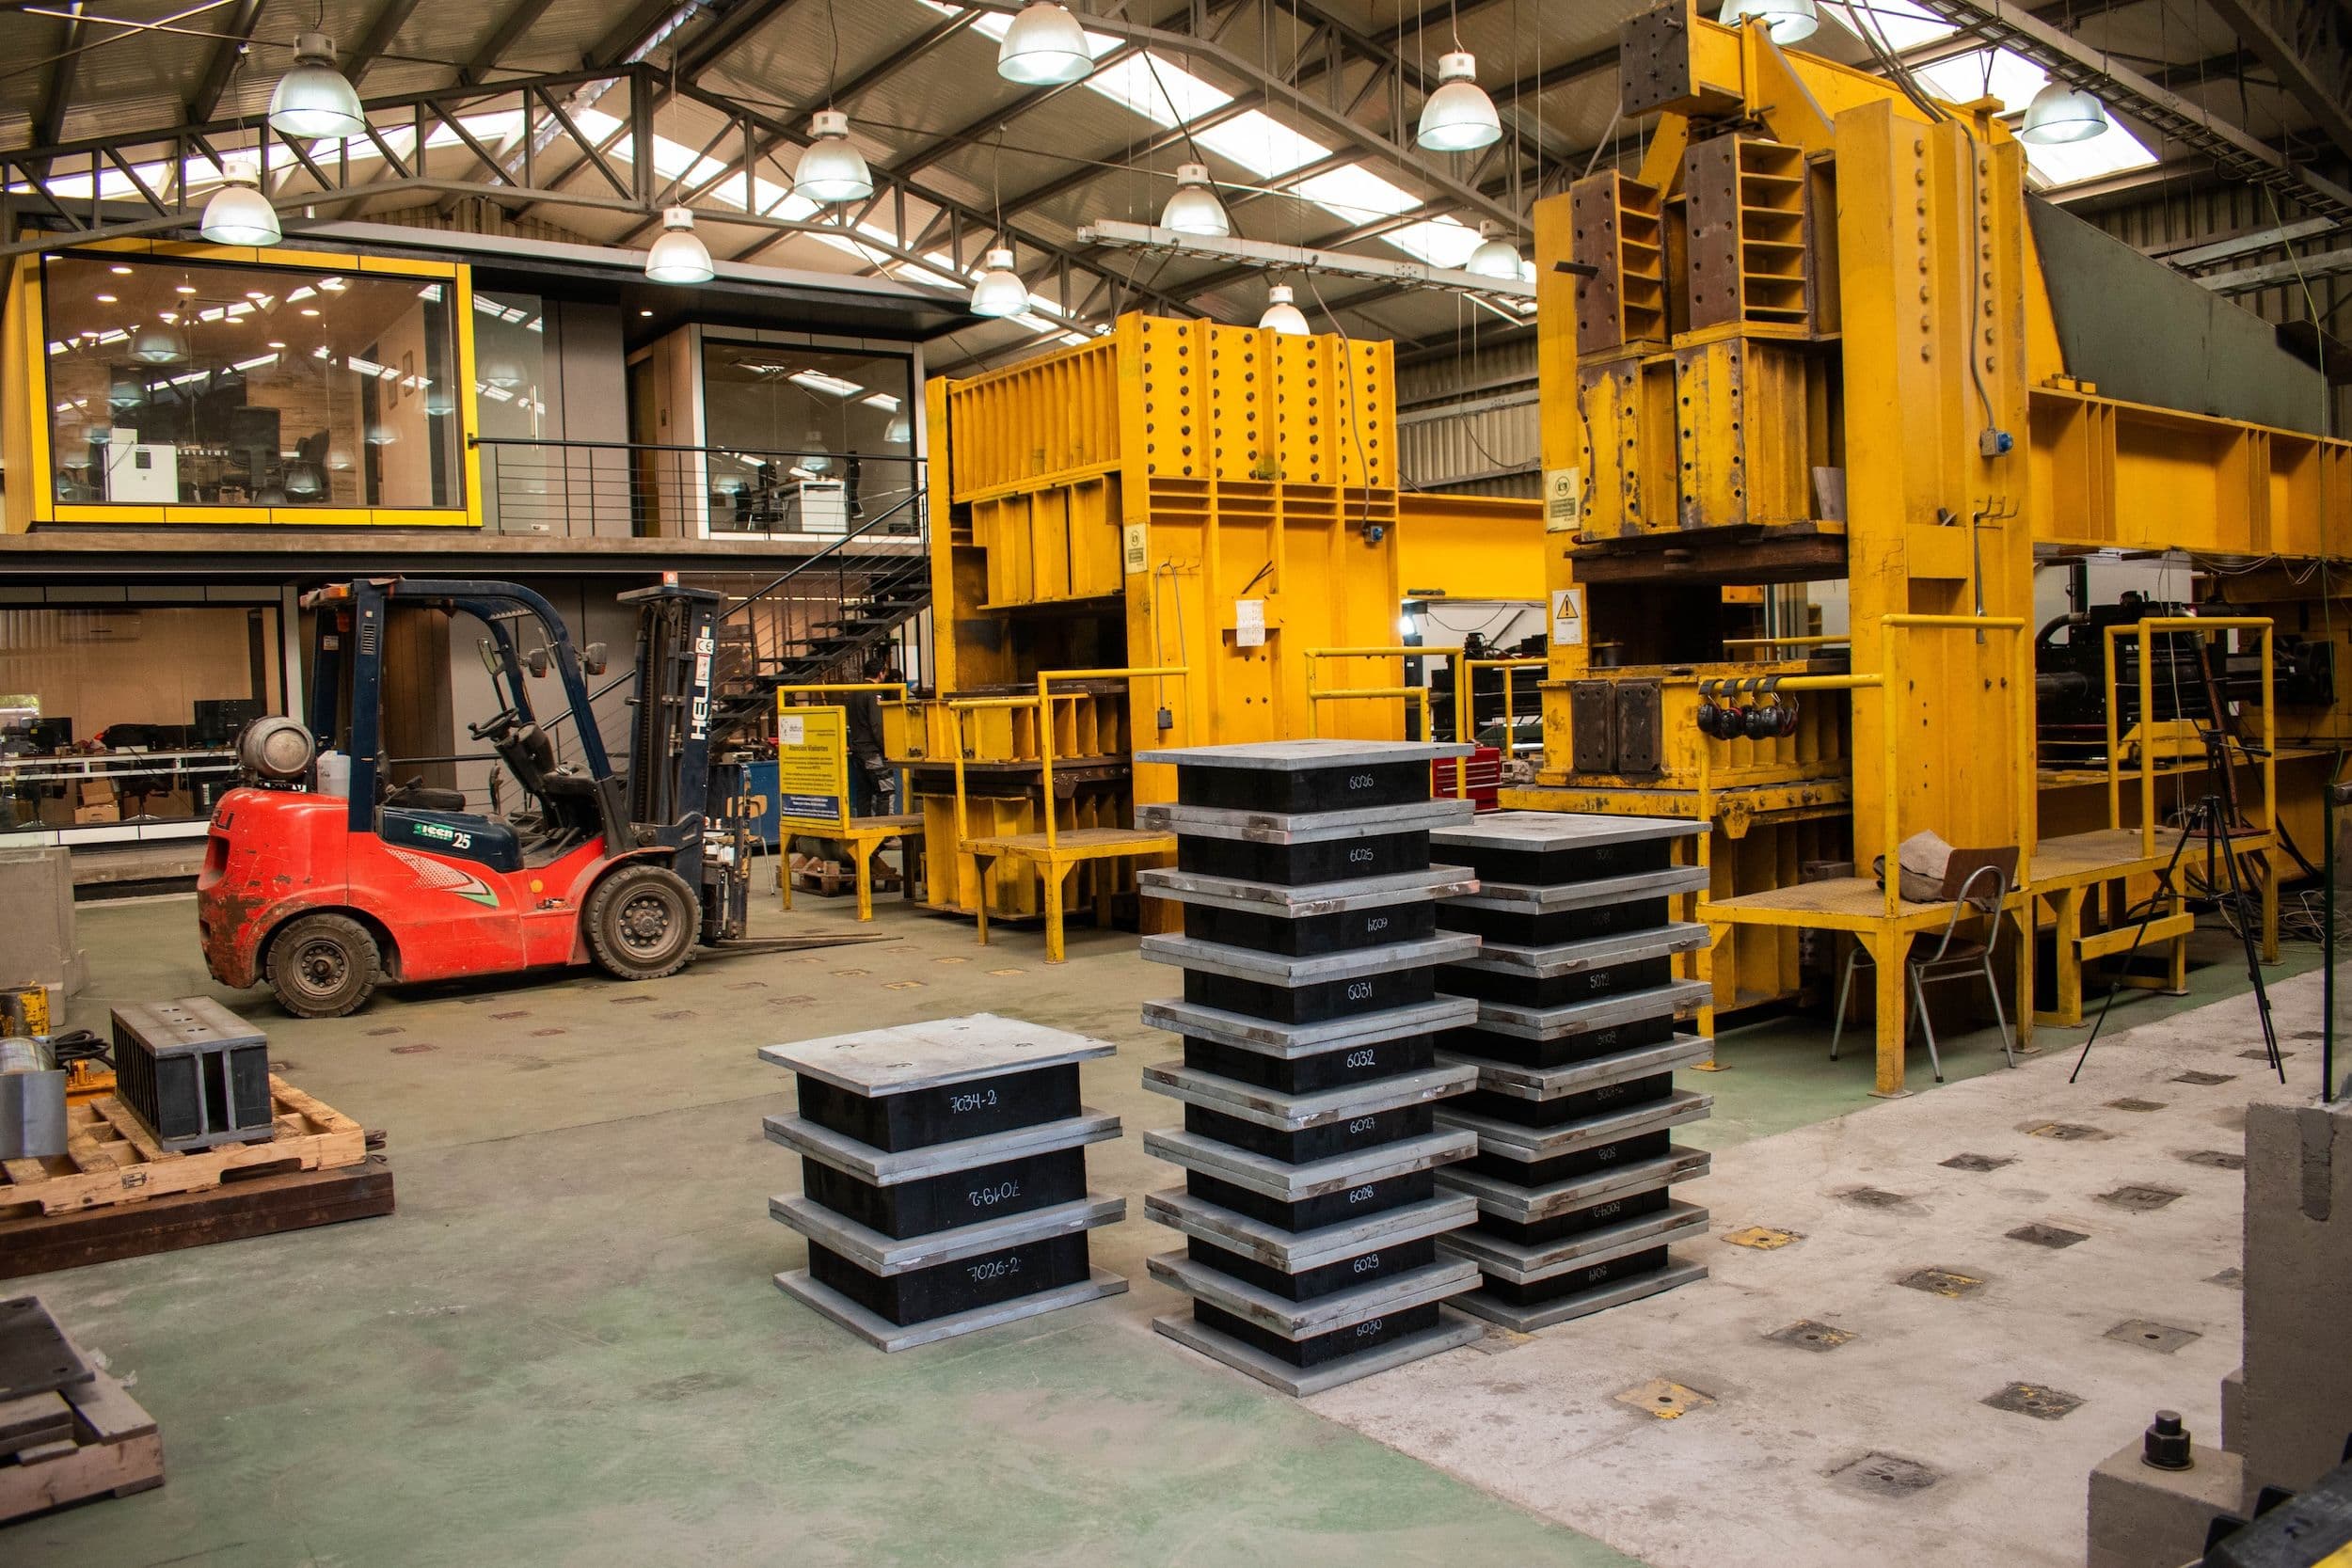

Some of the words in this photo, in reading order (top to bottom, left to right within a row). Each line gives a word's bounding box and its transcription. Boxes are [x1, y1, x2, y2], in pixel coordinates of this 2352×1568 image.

[691, 679, 710, 741] HELI
[1349, 773, 1375, 790] 6026
[452, 832, 472, 849] 25
[1349, 847, 1375, 863] 6025
[1367, 917, 1389, 932] 6024
[1347, 981, 1374, 1001] 6031
[1346, 1049, 1375, 1069] 6032
[949, 1088, 998, 1115] 7034-2
[1349, 1117, 1375, 1134] 6027
[968, 1180, 1022, 1208] 7019-2
[1349, 1184, 1375, 1204] 6028
[966, 1256, 1021, 1283] 7026-2
[1353, 1253, 1379, 1274] 6029
